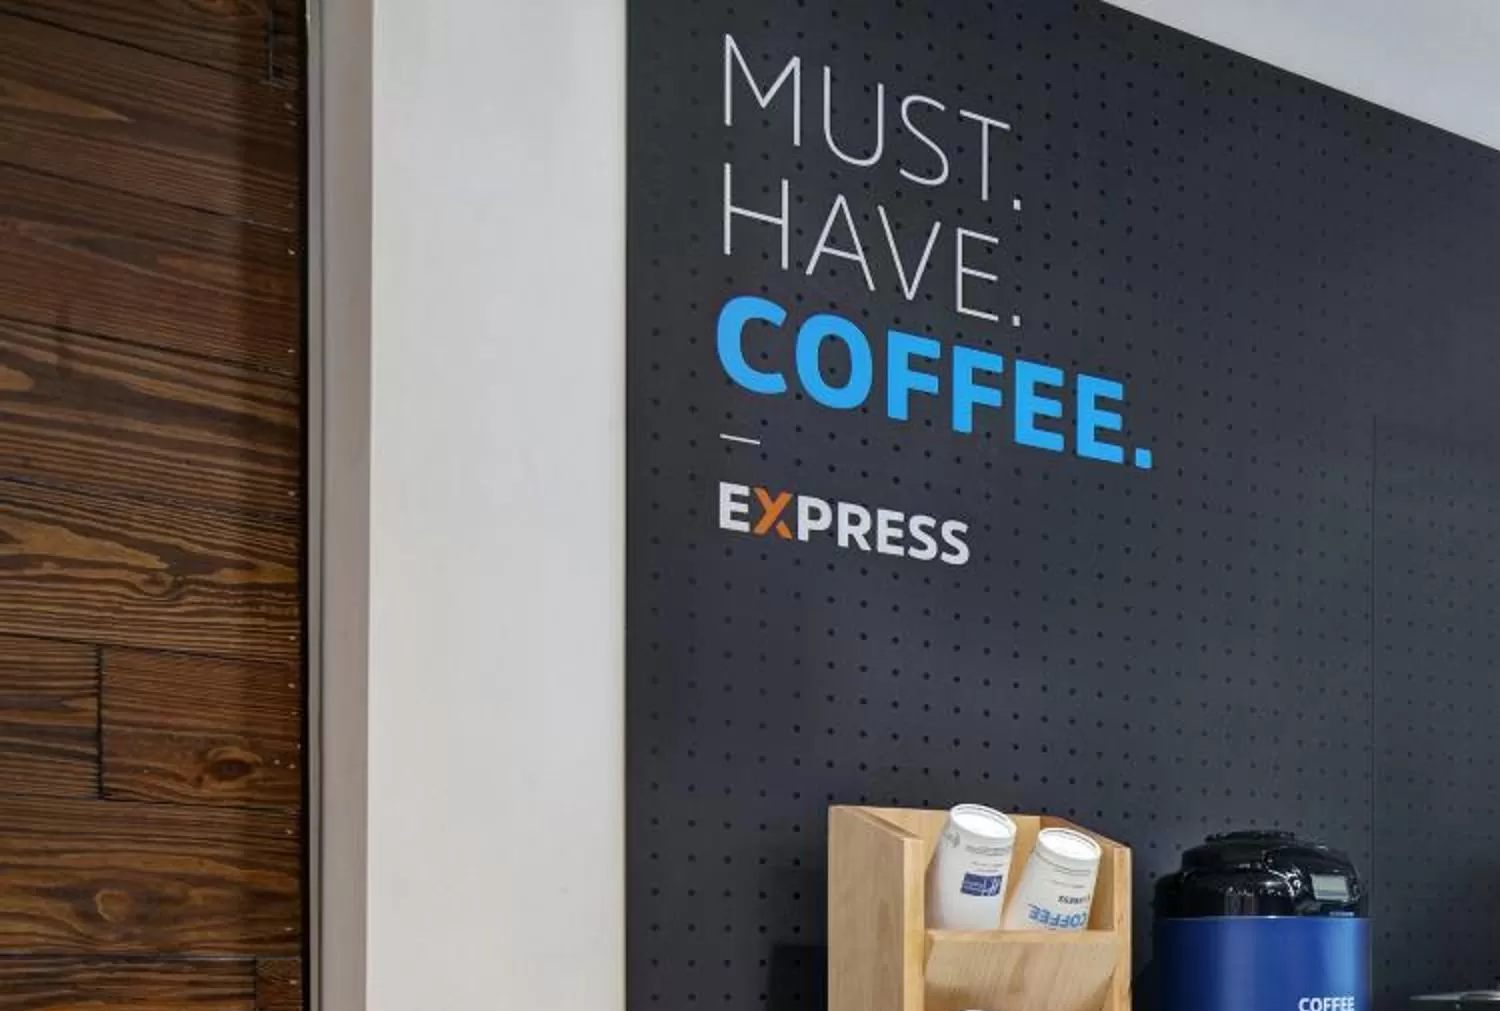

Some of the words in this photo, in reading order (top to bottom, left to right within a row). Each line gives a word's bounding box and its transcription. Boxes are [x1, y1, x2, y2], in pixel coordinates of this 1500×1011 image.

[723, 33, 1021, 211] MUST.
[723, 162, 1021, 327] HAVE.
[716, 295, 1152, 469] COFFEE.
[719, 481, 970, 566] EXPRESS
